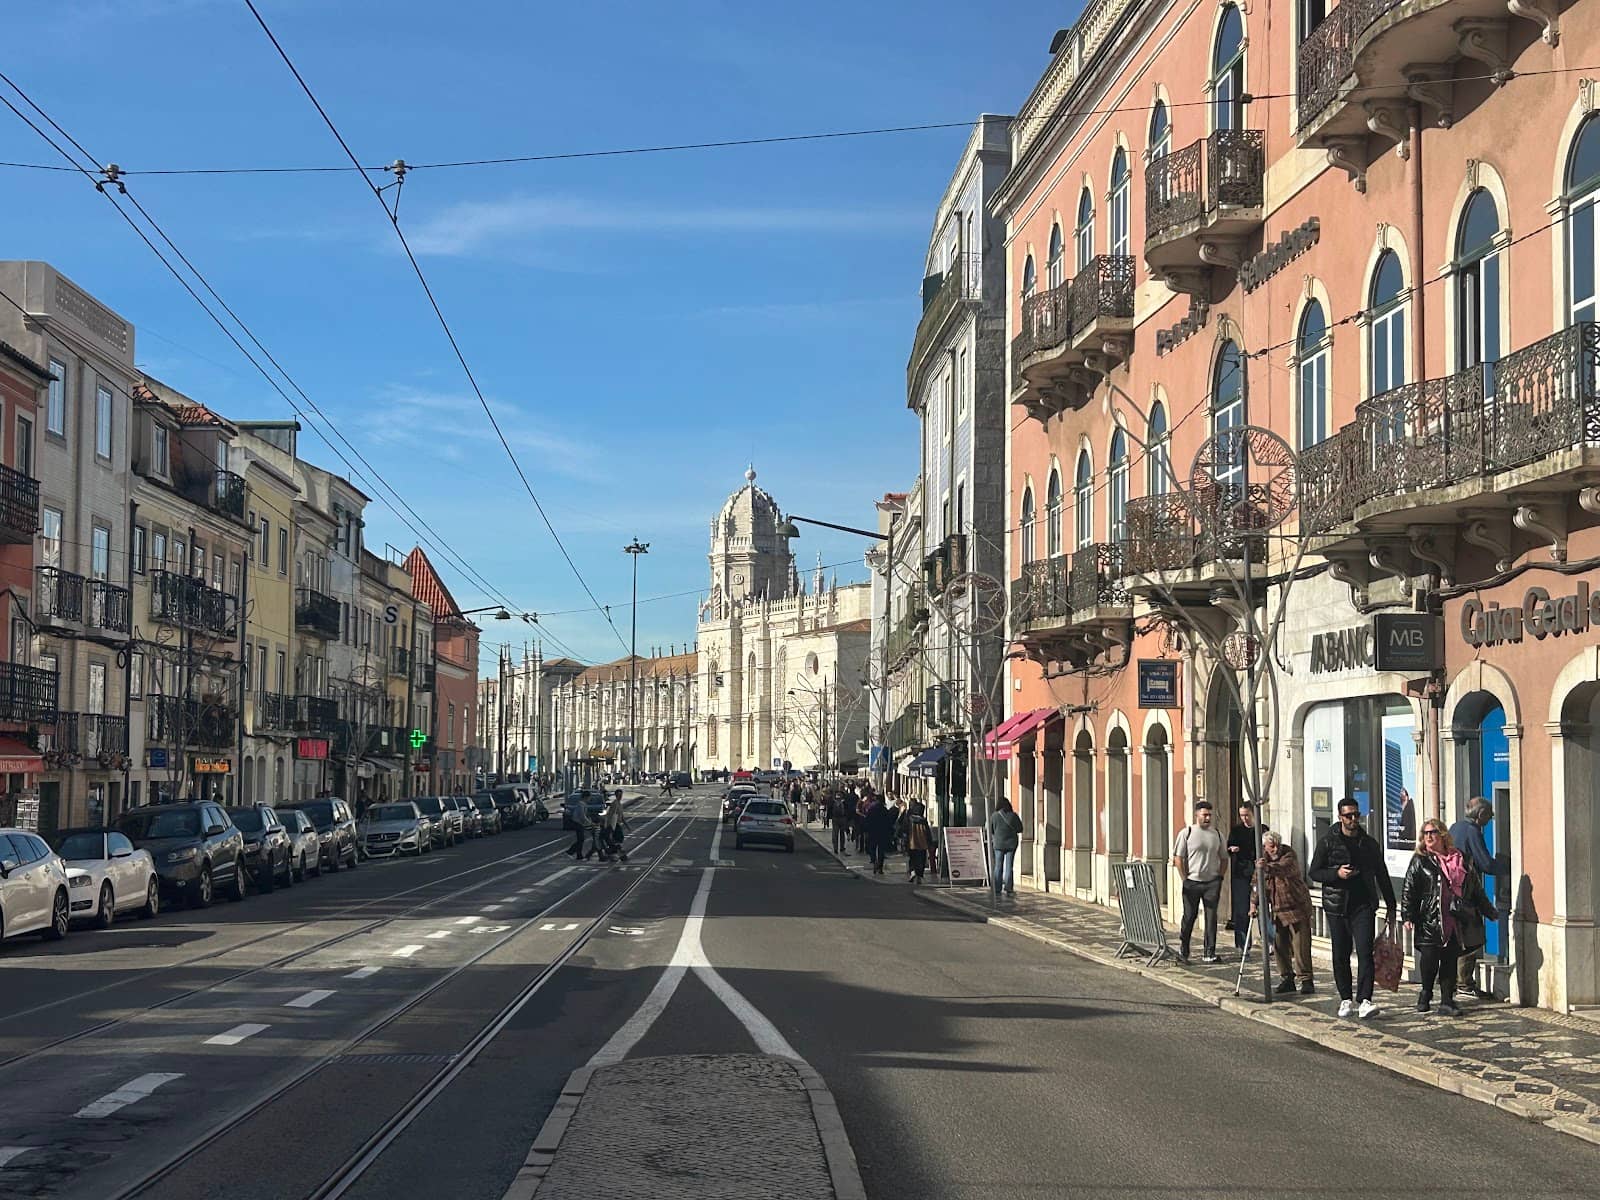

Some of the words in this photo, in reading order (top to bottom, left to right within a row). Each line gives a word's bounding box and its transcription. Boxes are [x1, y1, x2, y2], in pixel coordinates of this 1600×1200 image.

[384, 605, 398, 624] S
[1460, 598, 1523, 647] Caixa
[1522, 580, 1590, 637] Geral
[1389, 628, 1425, 647] MB
[1310, 624, 1376, 673] ABANC
[715, 676, 723, 686] S
